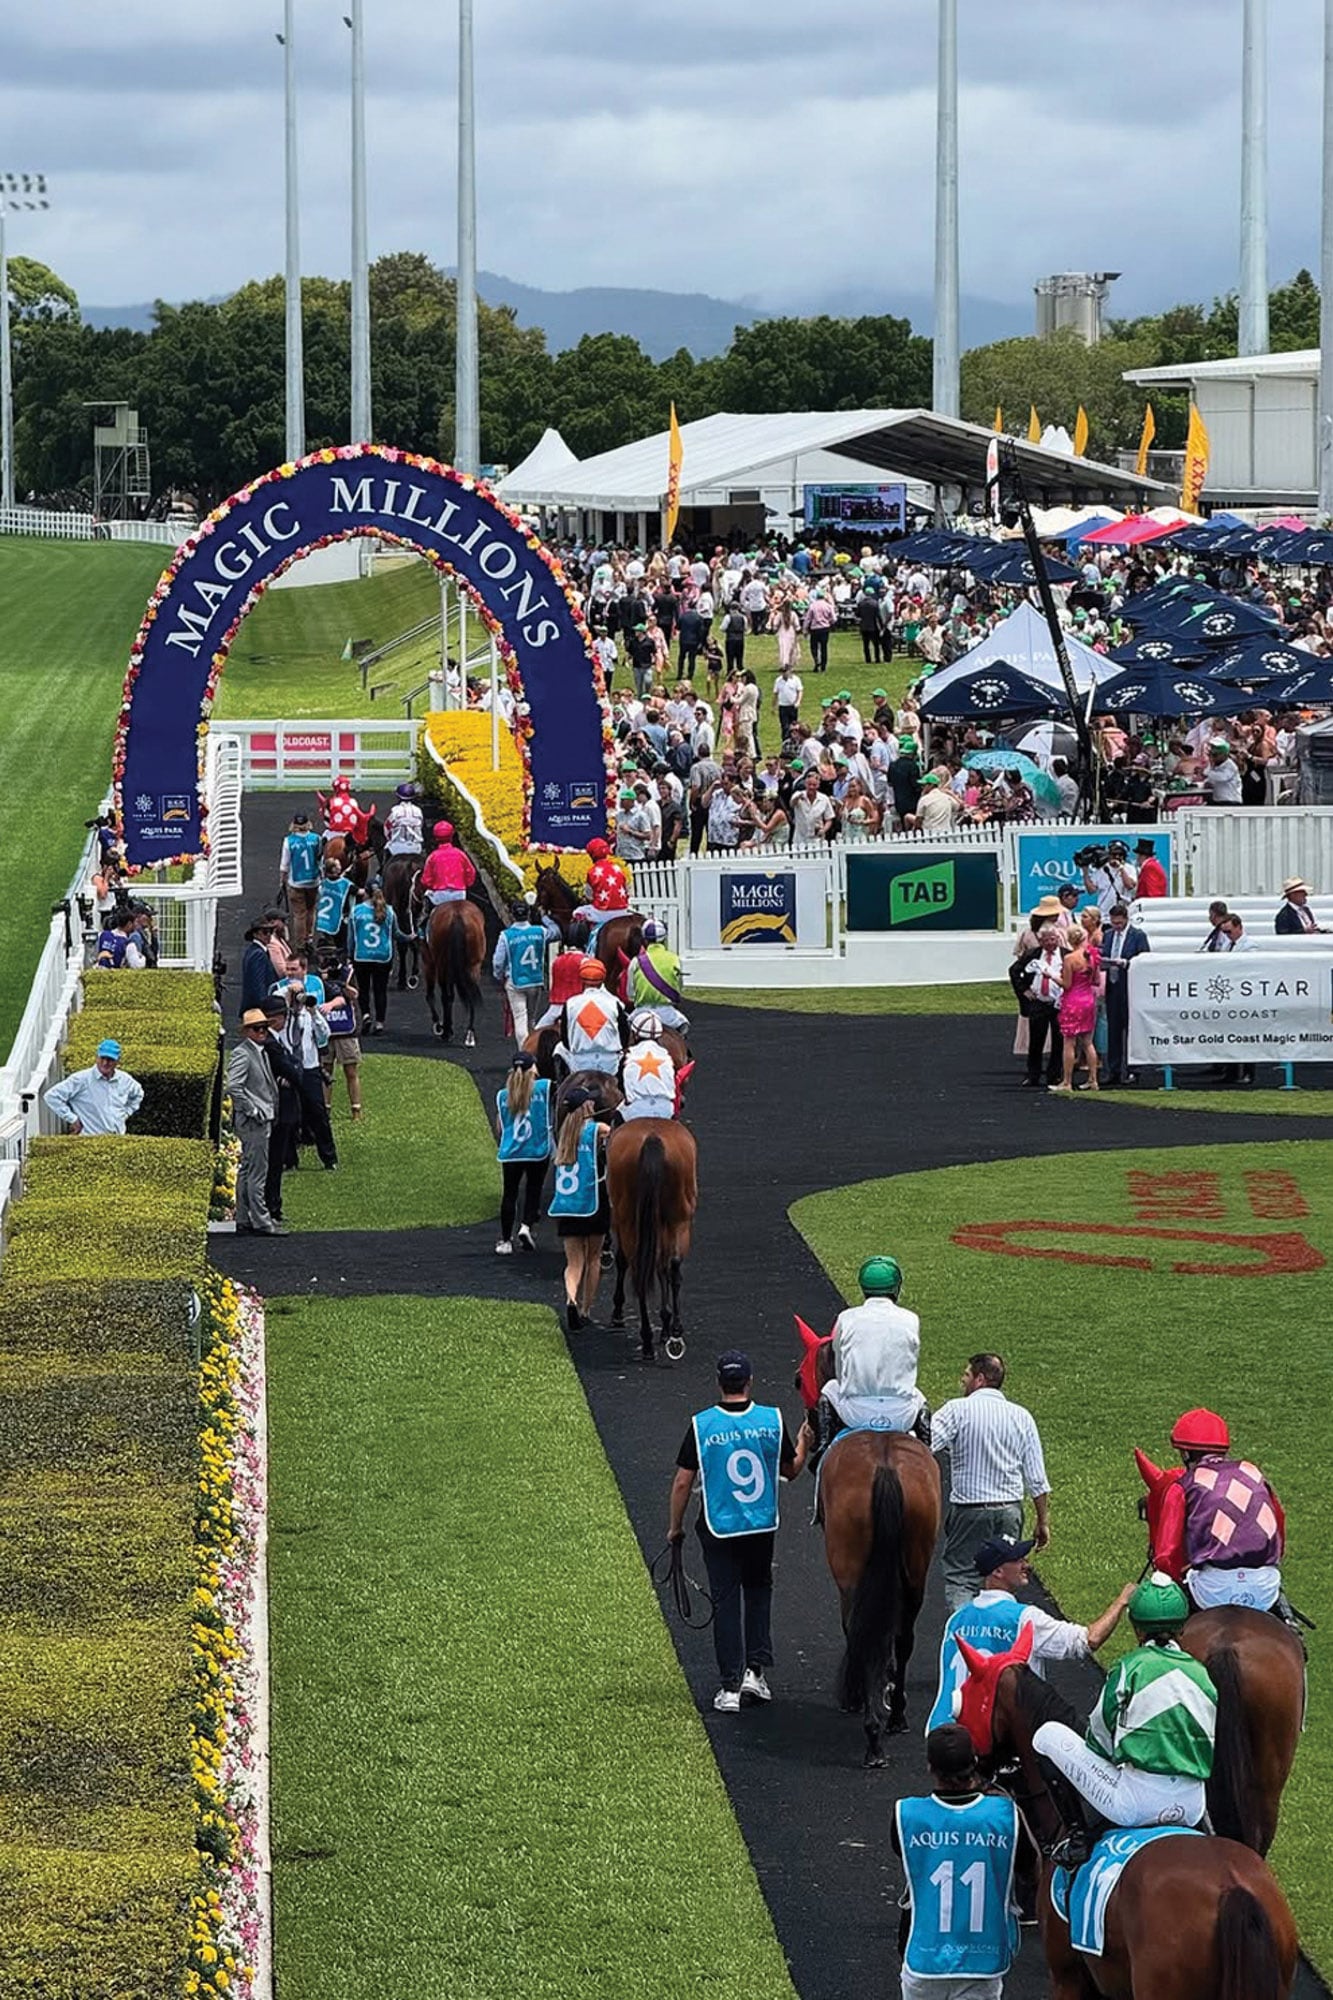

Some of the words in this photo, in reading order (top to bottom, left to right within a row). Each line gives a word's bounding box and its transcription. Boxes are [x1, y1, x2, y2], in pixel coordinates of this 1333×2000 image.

[165, 502, 300, 658] MAGIC
[329, 477, 560, 648] MILLIONS
[301, 850, 310, 870] 1
[731, 884, 785, 899] MAGIC
[898, 882, 948, 904] TAB
[317, 895, 334, 920] 2
[731, 898, 784, 908] MILLIONS
[363, 922, 381, 948] 3
[520, 944, 539, 970] 4
[1149, 981, 1198, 998] THE
[1240, 980, 1309, 997] STAR
[326, 1010, 349, 1021] EDIA
[1179, 1010, 1221, 1020] GOLD
[1227, 1009, 1278, 1019] COAST
[1149, 1036, 1170, 1046] The
[1172, 1034, 1195, 1045] Star
[1199, 1034, 1225, 1044] Gold
[1227, 1033, 1260, 1044] Coast
[1263, 1033, 1296, 1046] Magic
[512, 1110, 532, 1143] 6
[556, 1162, 580, 1196] 8
[704, 1429, 742, 1447] AQUIS
[744, 1426, 779, 1441] PARK
[726, 1448, 766, 1503] 9
[909, 1831, 961, 1851] AQUIS
[964, 1832, 1009, 1850] PARK
[929, 1860, 986, 1933] 11
